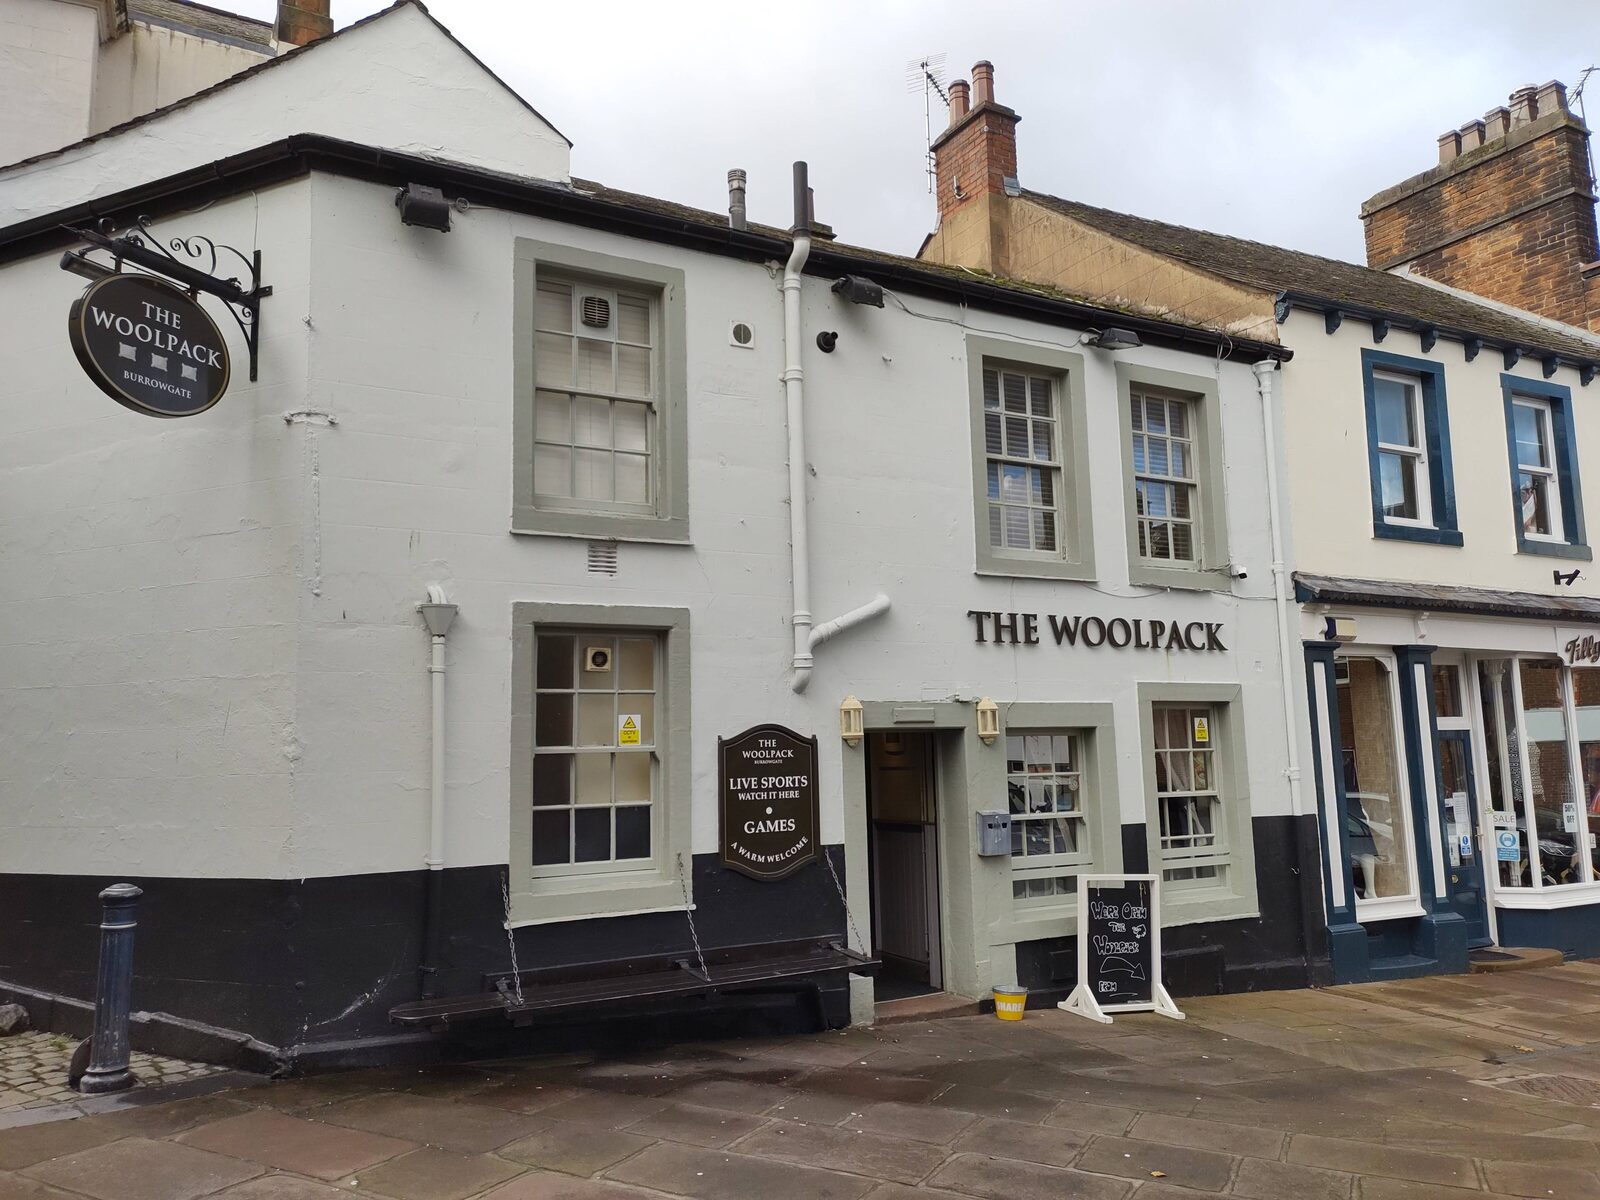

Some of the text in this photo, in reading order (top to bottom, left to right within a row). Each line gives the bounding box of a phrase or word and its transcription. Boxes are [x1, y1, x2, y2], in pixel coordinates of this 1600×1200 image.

[141, 301, 181, 329] THE
[91, 306, 221, 369] WOOLPACK
[123, 370, 192, 398] BURROWGATE
[967, 610, 1229, 652] THE WOOLPACK
[758, 739, 777, 748] THE
[742, 749, 794, 759] WOOLPACK
[729, 775, 808, 790] LIVE SPORTS
[738, 790, 800, 801] WATCH IT HERE
[744, 819, 795, 833] GAMES
[1493, 814, 1516, 823] SALE
[730, 835, 809, 863] A WARM WELCOME
